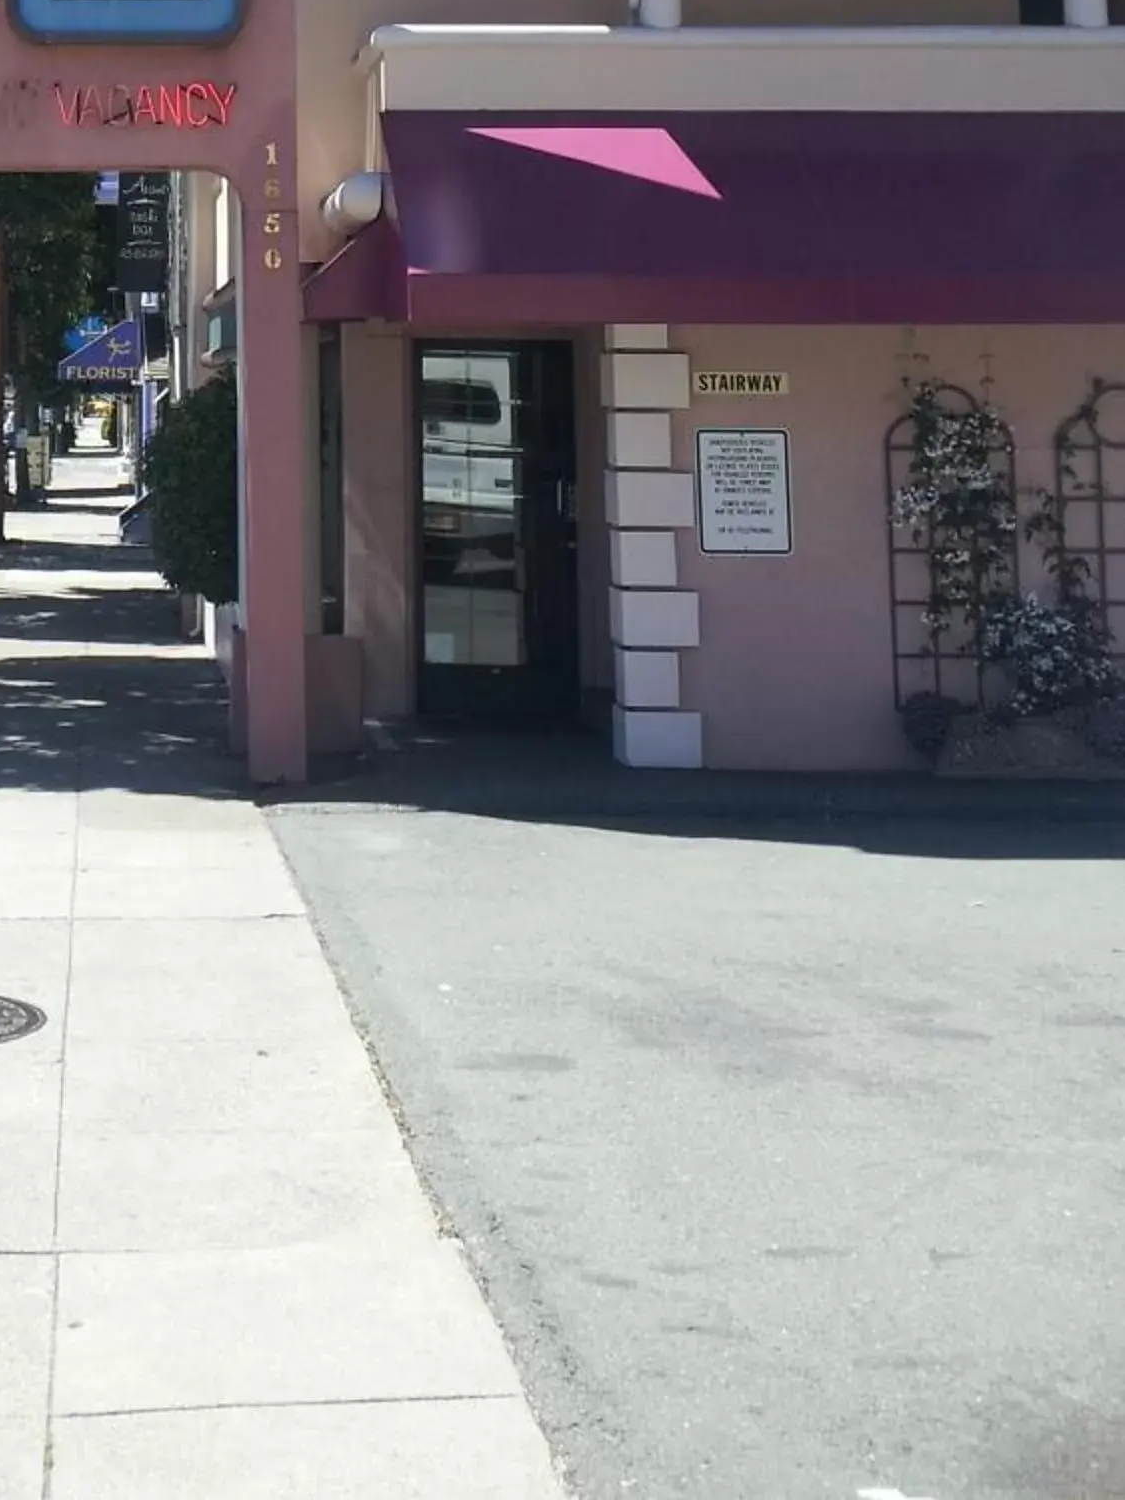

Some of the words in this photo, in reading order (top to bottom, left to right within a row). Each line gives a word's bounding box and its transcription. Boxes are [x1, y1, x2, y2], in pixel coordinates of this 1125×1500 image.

[53, 82, 236, 127] VACANCY
[66, 365, 135, 380] FLORIST
[698, 374, 782, 392] STAIRWAY
